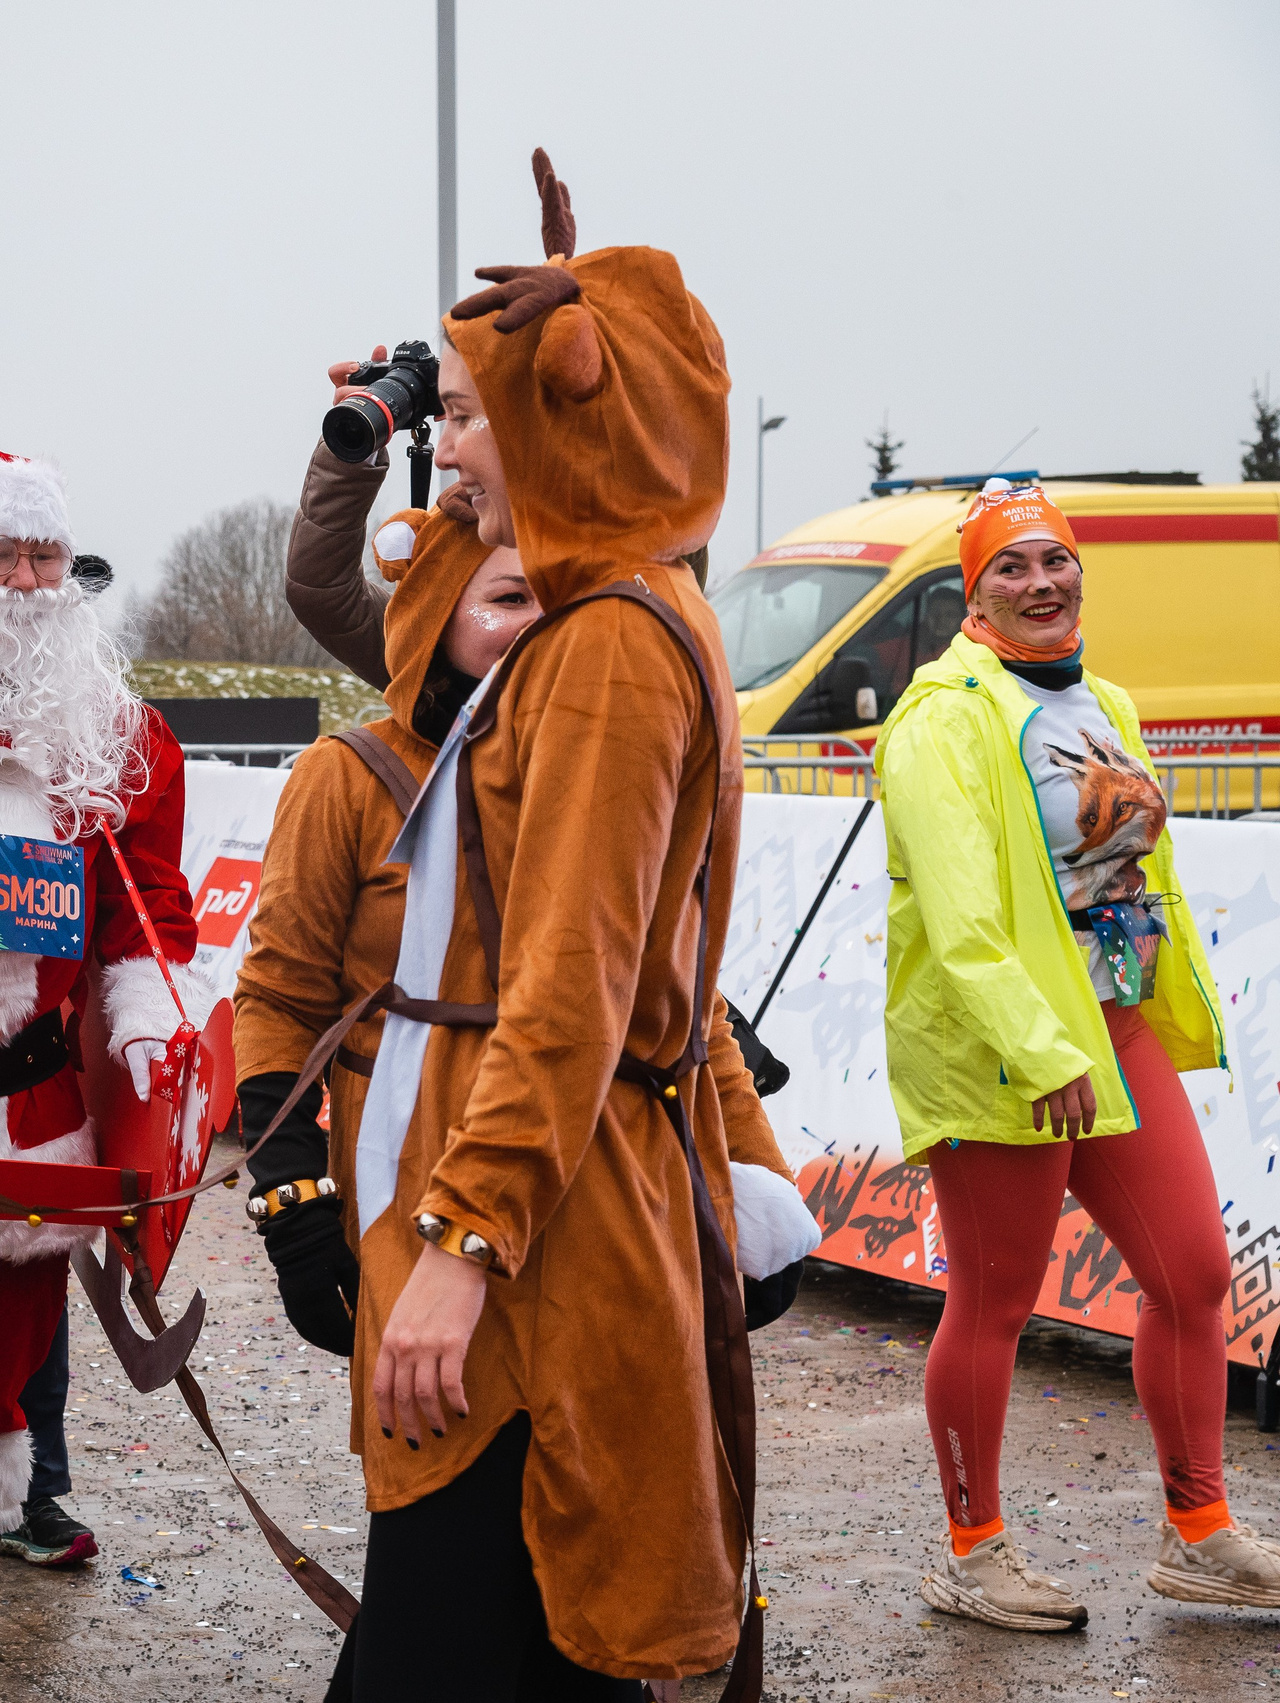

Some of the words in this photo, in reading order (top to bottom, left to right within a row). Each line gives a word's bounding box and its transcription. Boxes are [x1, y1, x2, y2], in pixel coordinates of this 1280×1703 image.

[1002, 506, 1025, 518] MAD
[1026, 505, 1045, 515] FOX
[1010, 512, 1041, 524] ULTRA
[15, 916, 58, 931] МАРИНА
[947, 1427, 969, 1490] HILFIGER
